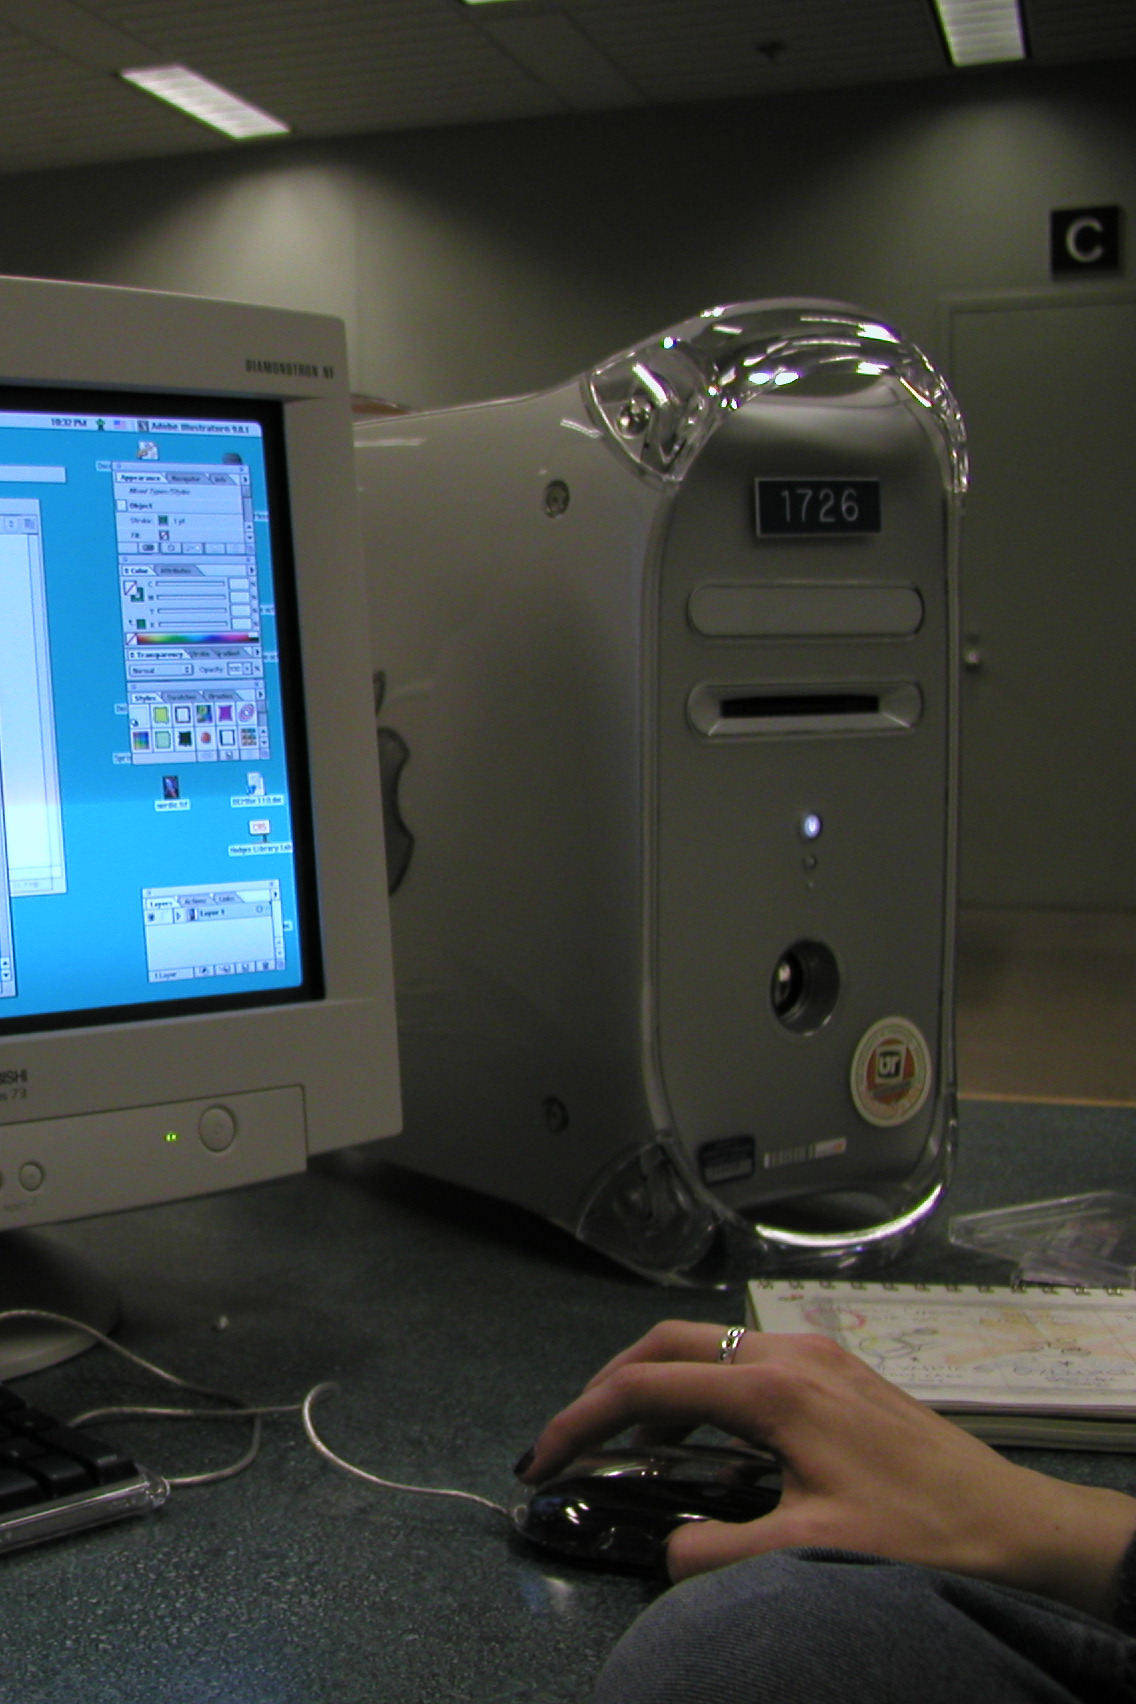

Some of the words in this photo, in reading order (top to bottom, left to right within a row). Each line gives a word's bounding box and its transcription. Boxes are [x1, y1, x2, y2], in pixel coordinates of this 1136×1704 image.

[1066, 218, 1104, 263] C
[74, 418, 88, 428] PM
[151, 423, 179, 432] Adobe
[780, 488, 859, 523] 1726
